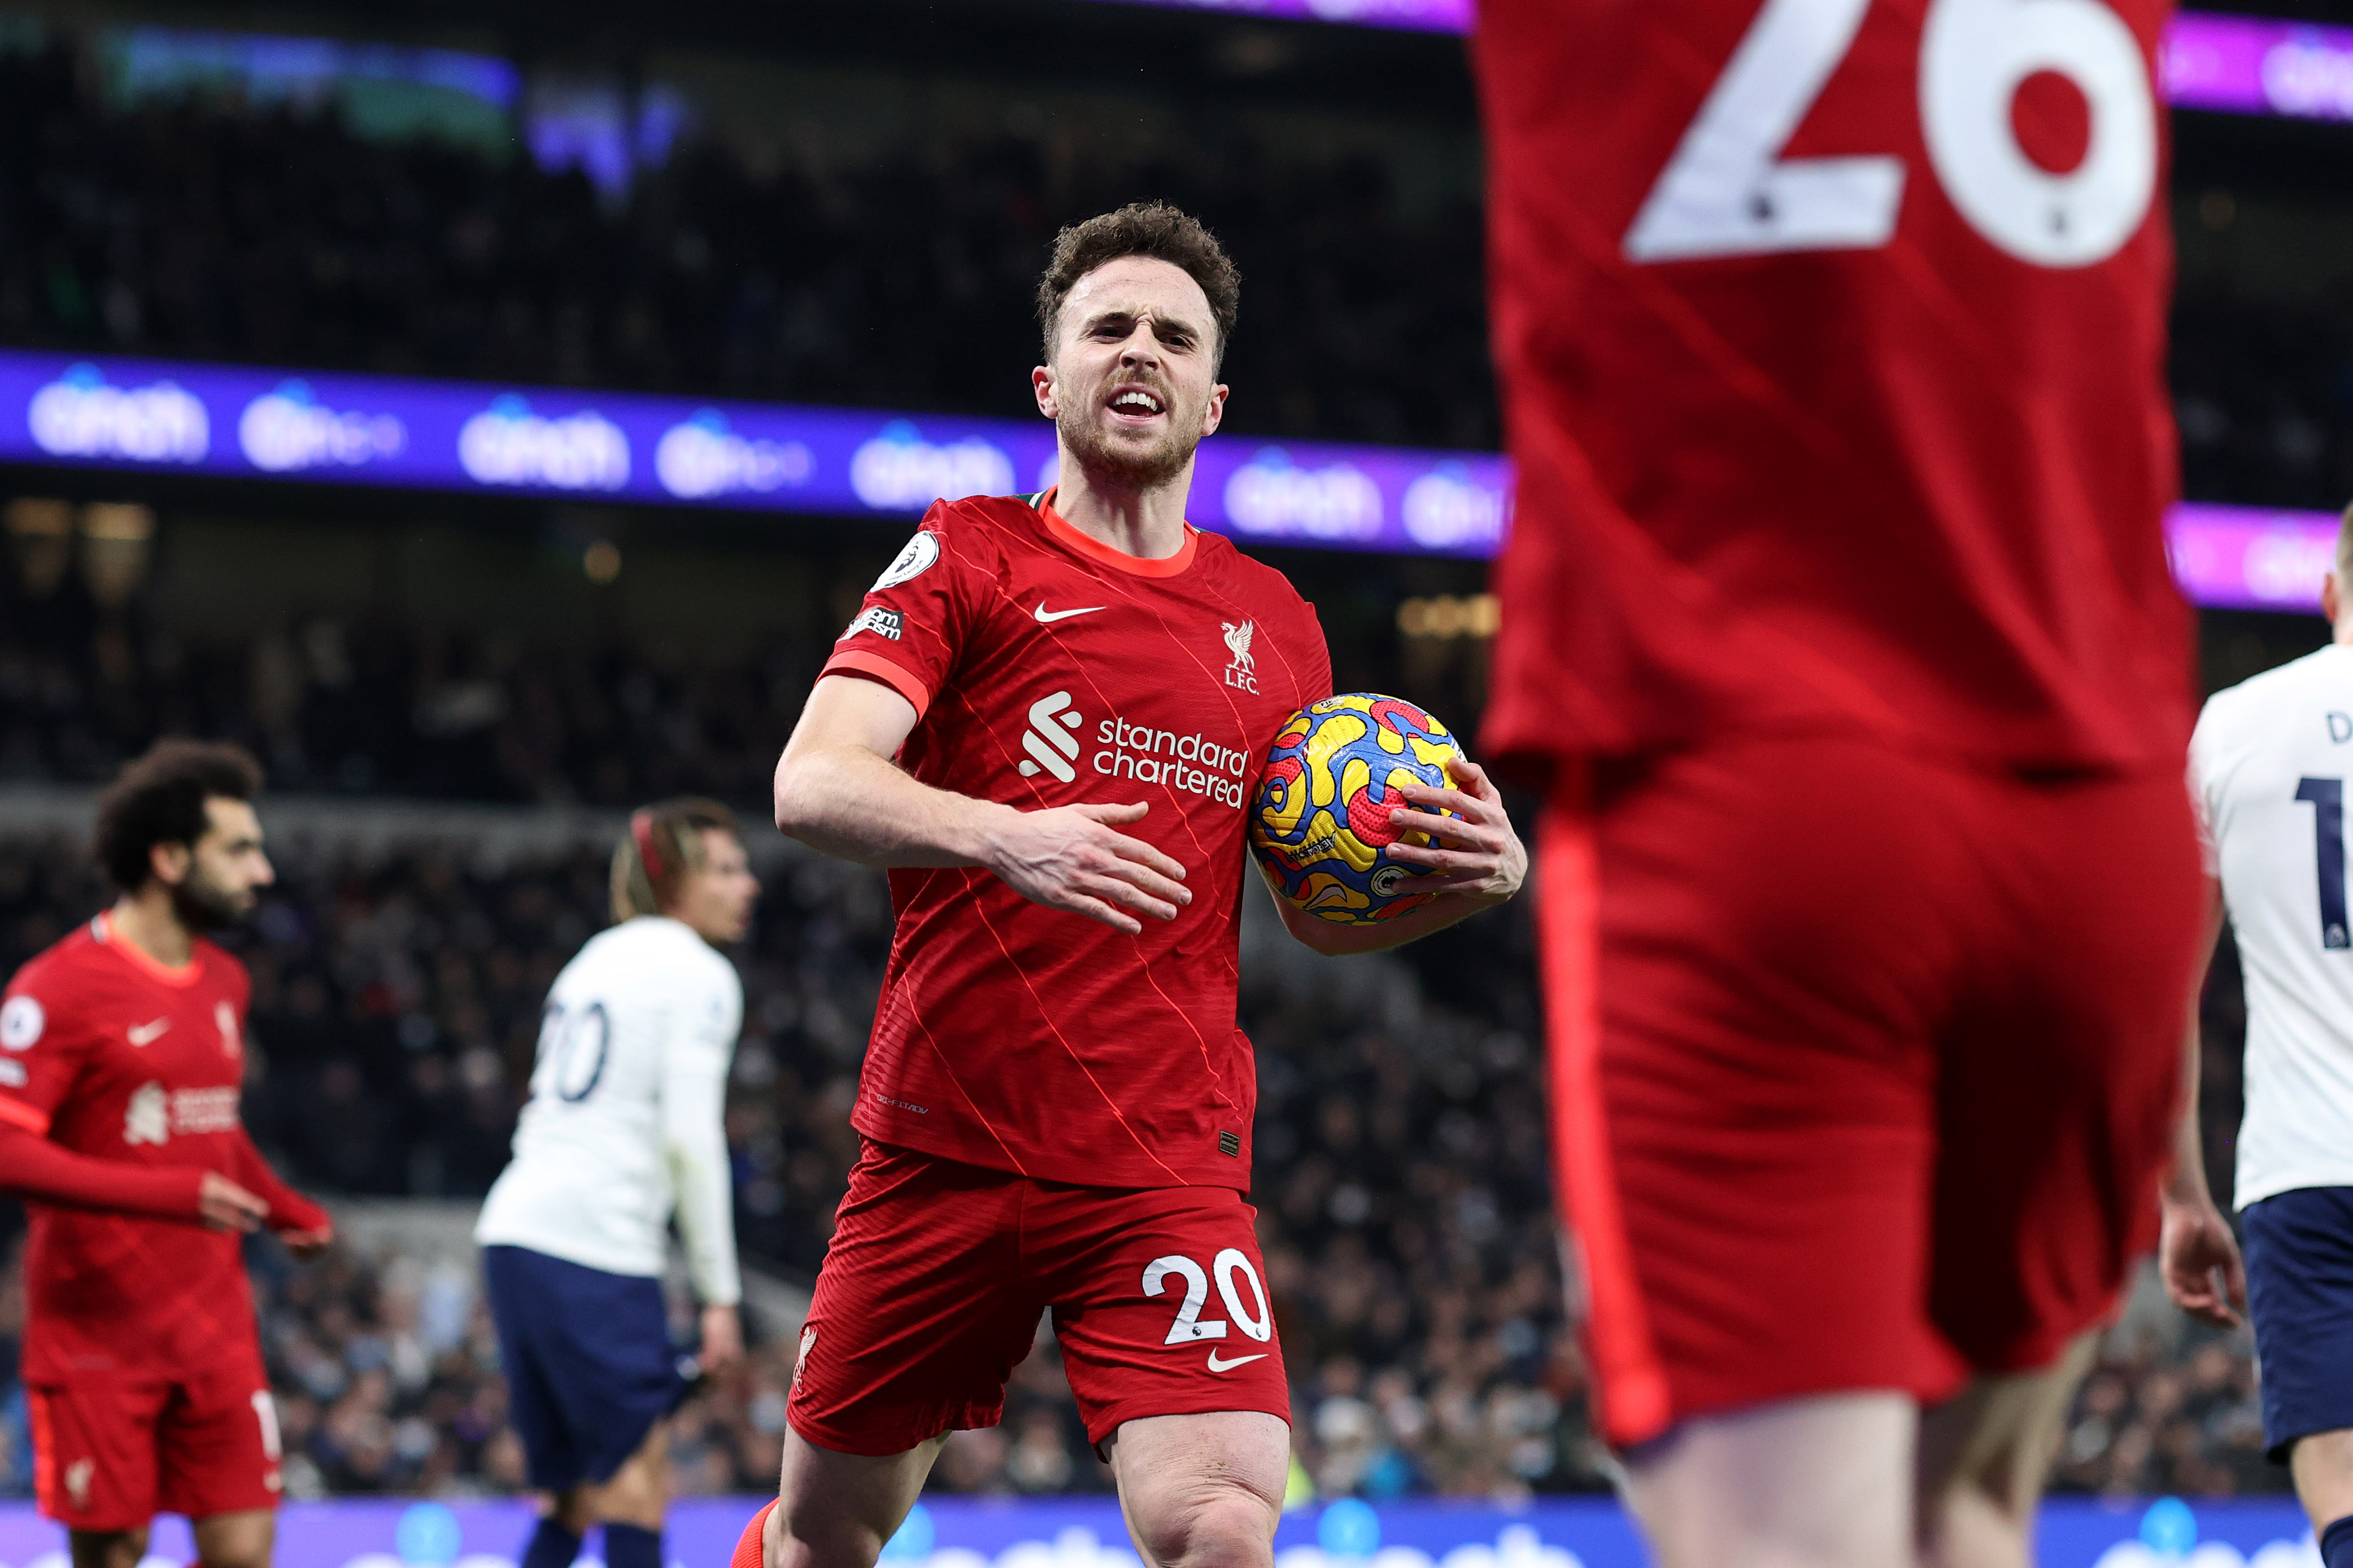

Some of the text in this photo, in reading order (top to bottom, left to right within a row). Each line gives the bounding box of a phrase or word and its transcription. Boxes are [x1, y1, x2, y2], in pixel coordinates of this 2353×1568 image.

[1621, 0, 2158, 268] 26
[1225, 669, 1260, 695] L.F.C.
[1097, 717, 1248, 778] standard
[1093, 748, 1244, 809] chartered
[1141, 1247, 1271, 1346] 20
